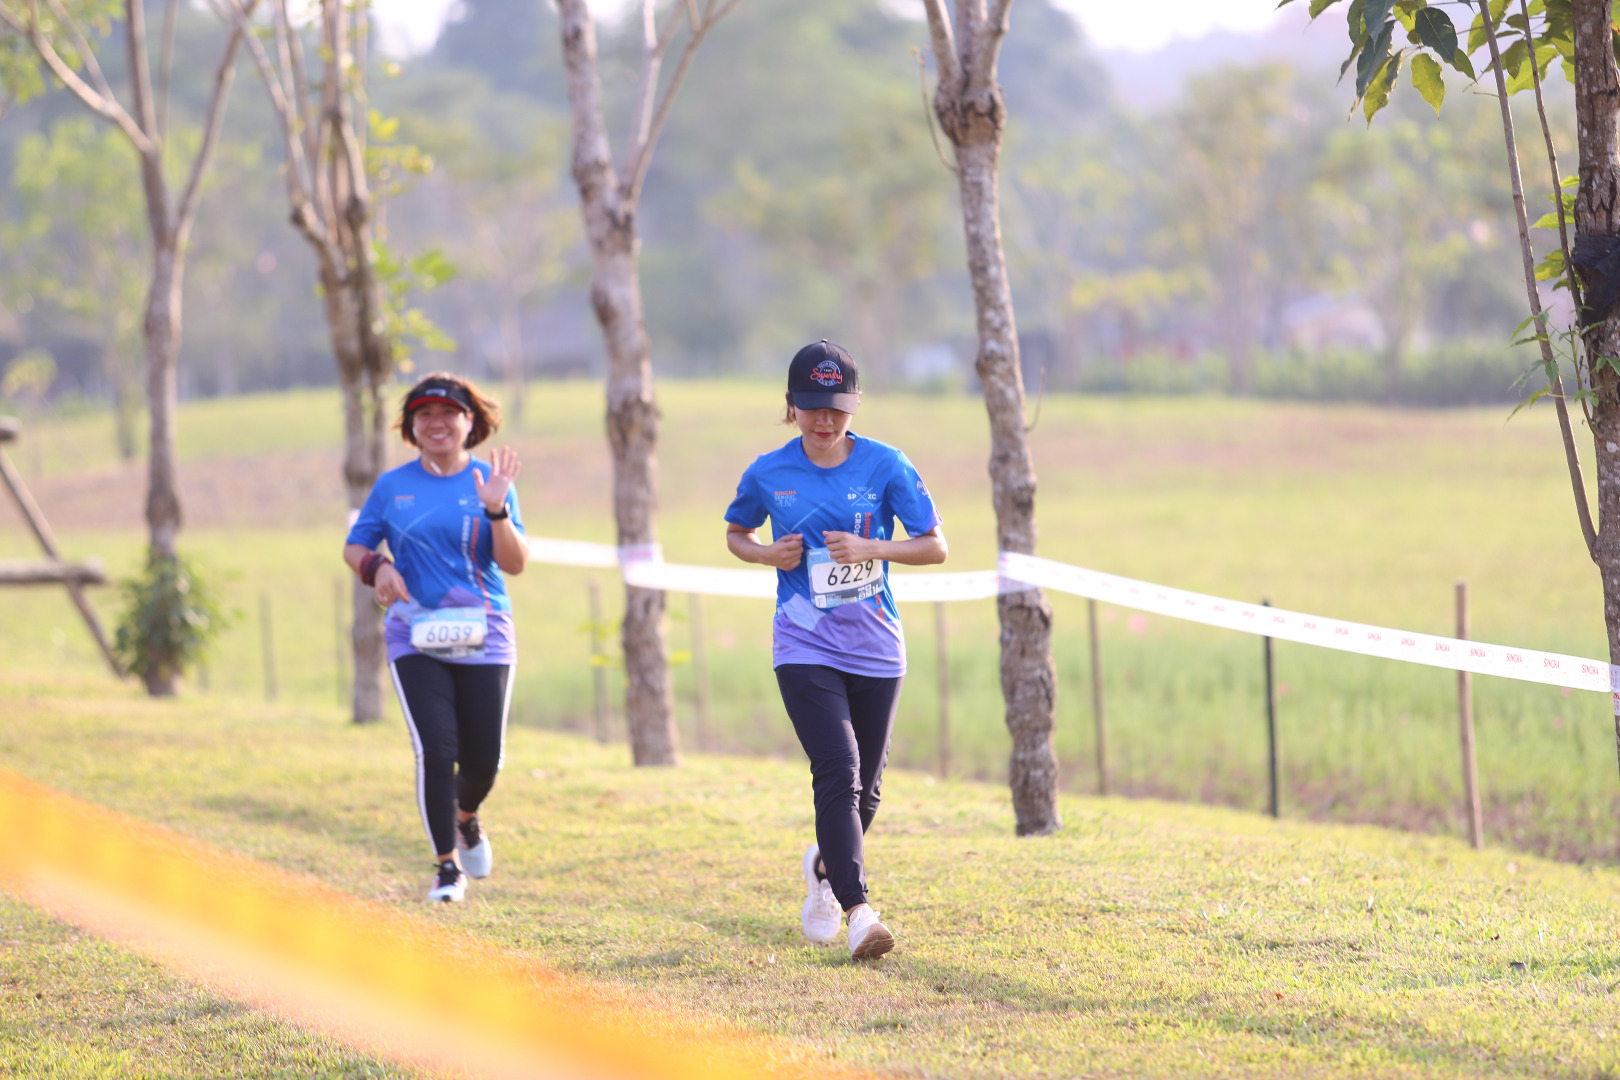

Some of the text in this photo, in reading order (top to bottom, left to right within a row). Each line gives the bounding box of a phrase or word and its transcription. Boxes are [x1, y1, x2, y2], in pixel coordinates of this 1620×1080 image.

[810, 367, 843, 385] Superdry
[827, 559, 874, 586] 6229
[426, 625, 473, 643] 6039
[1506, 652, 1523, 664] SINGHA
[1543, 658, 1560, 669] SINGHA
[1581, 663, 1599, 676] SINGHA
